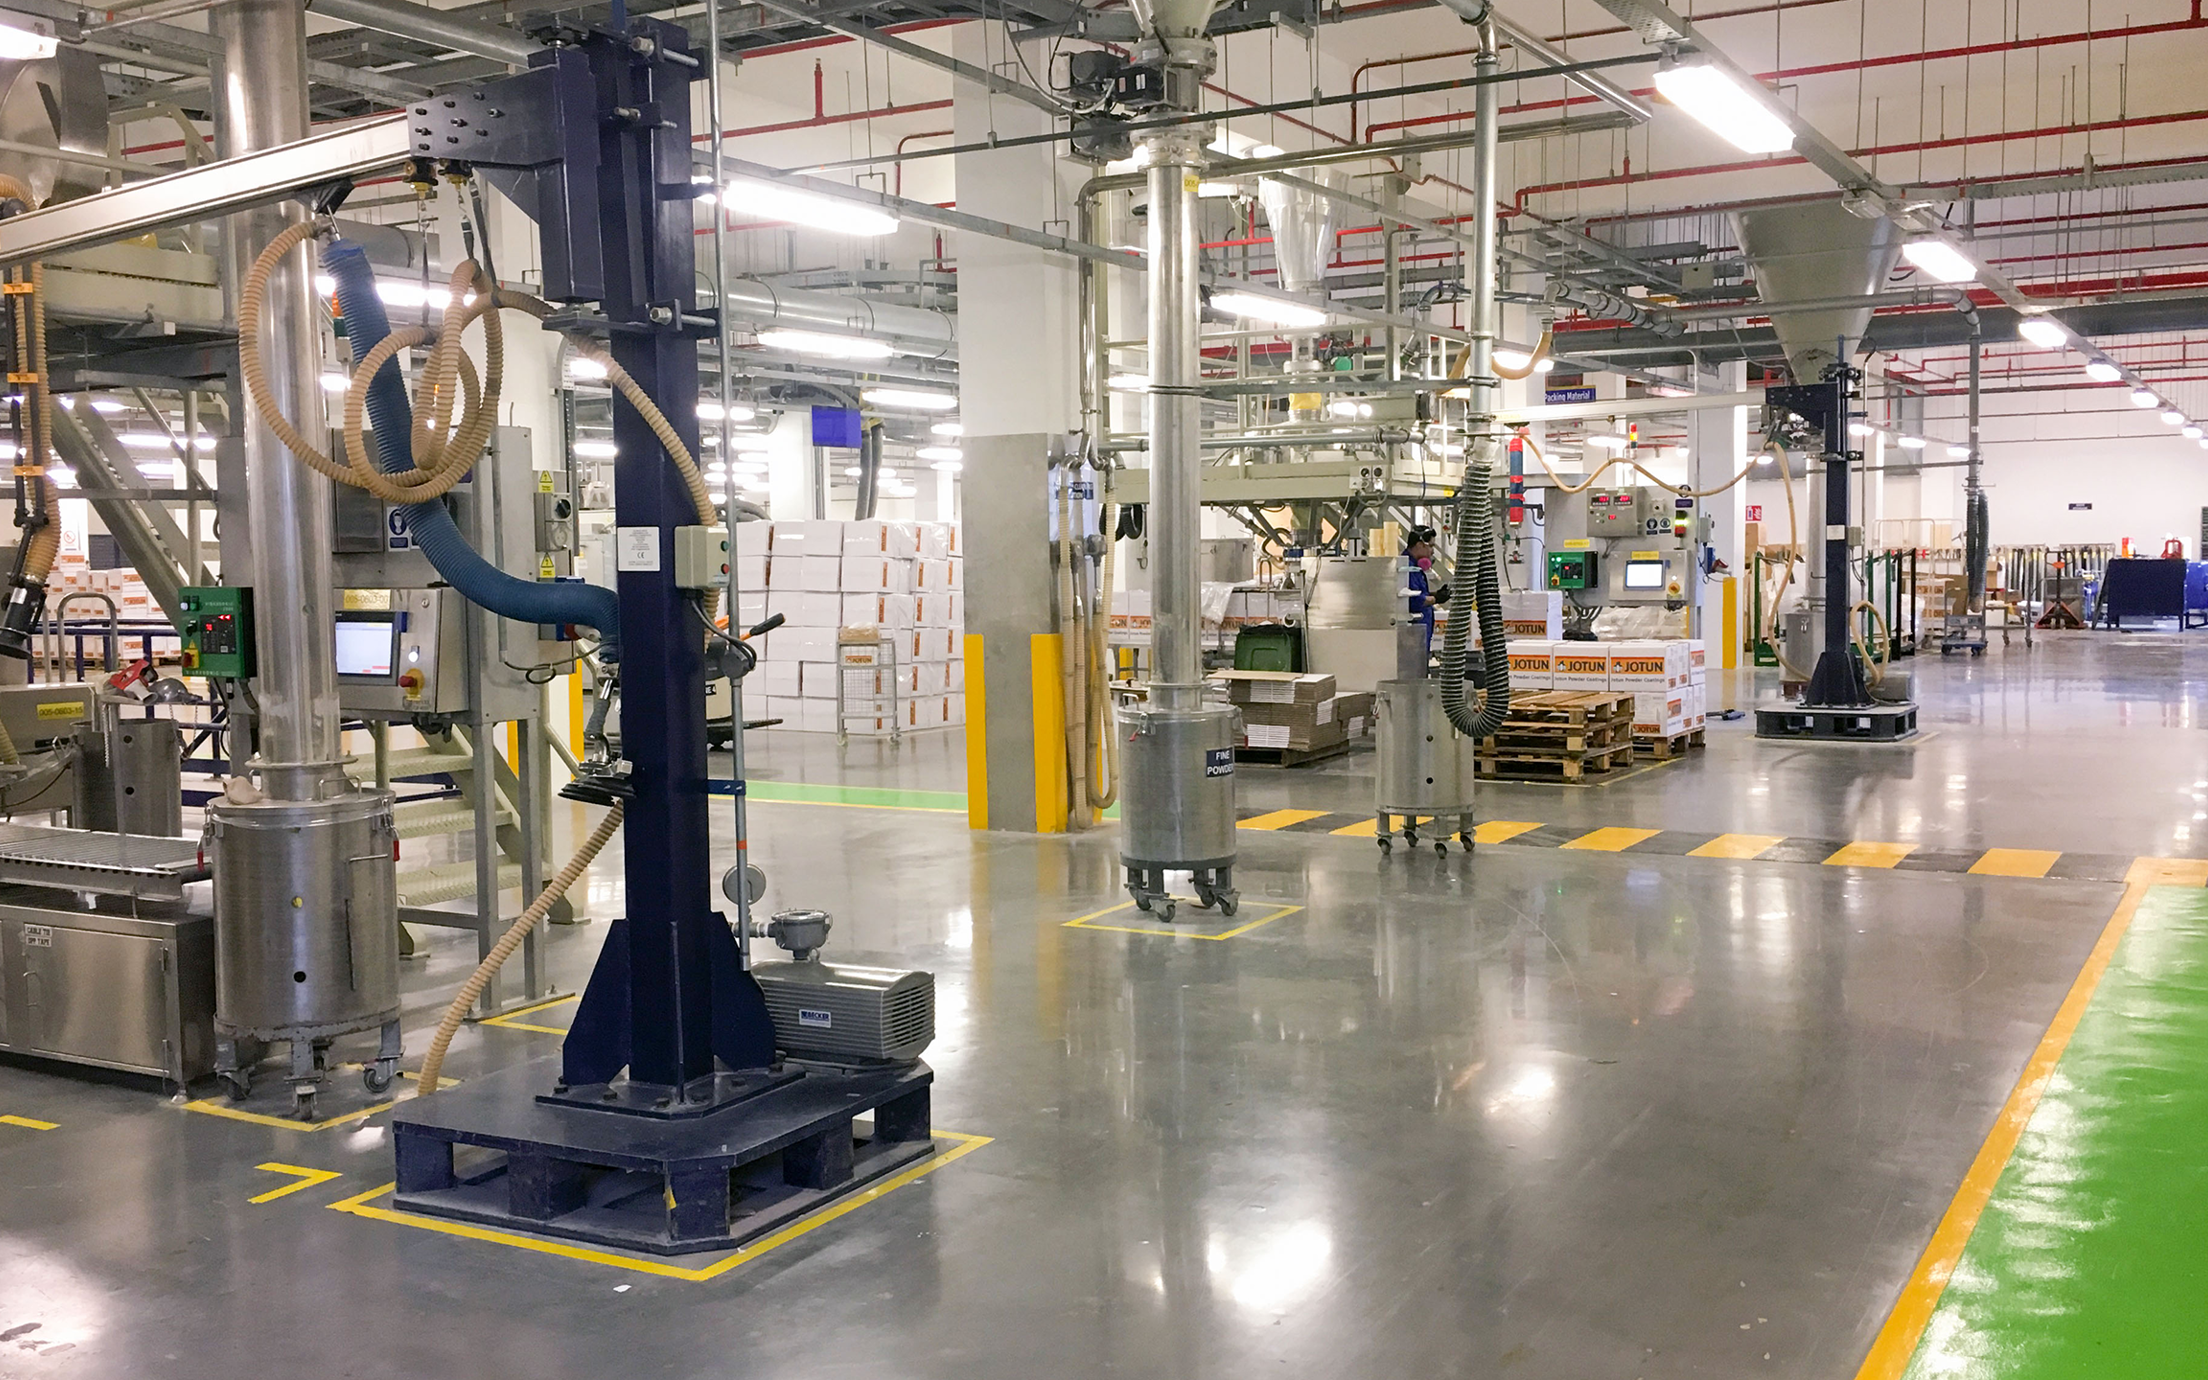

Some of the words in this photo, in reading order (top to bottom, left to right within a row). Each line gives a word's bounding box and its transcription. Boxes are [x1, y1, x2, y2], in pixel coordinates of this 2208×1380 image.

[1566, 390, 1590, 400] Material
[1513, 624, 1545, 634] JOTUN
[1513, 659, 1549, 670] JOTUN
[1568, 661, 1605, 672] JOTUN
[1624, 661, 1663, 672] JOTUN
[1215, 750, 1230, 760] FINE
[1207, 763, 1234, 775] POWDE
